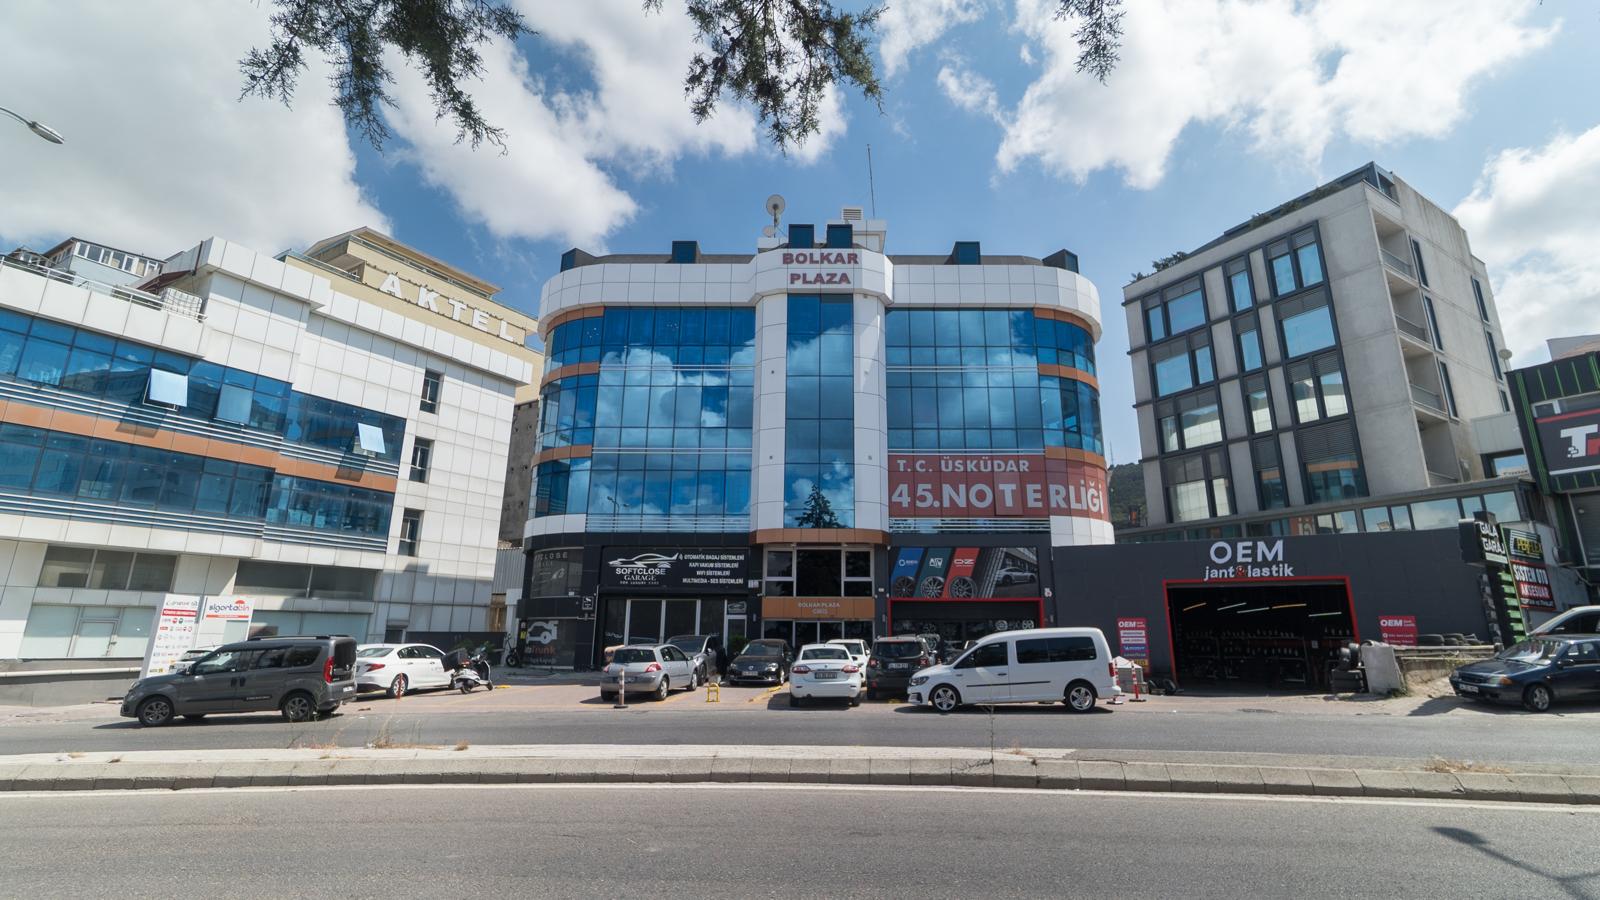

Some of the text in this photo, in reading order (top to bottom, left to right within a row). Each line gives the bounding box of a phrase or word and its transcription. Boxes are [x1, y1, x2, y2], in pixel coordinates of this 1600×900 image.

[782, 252, 859, 265] BOLKAR
[789, 272, 851, 285] PLAZA
[379, 273, 514, 342] AKTEL
[940, 456, 1030, 472] ÜSKÜDAR
[720, 553, 745, 561] SİSTEMLERİ
[1209, 539, 1284, 564] OEM
[615, 567, 666, 575] SOFTCLOSE
[1380, 619, 1403, 627] OEM
